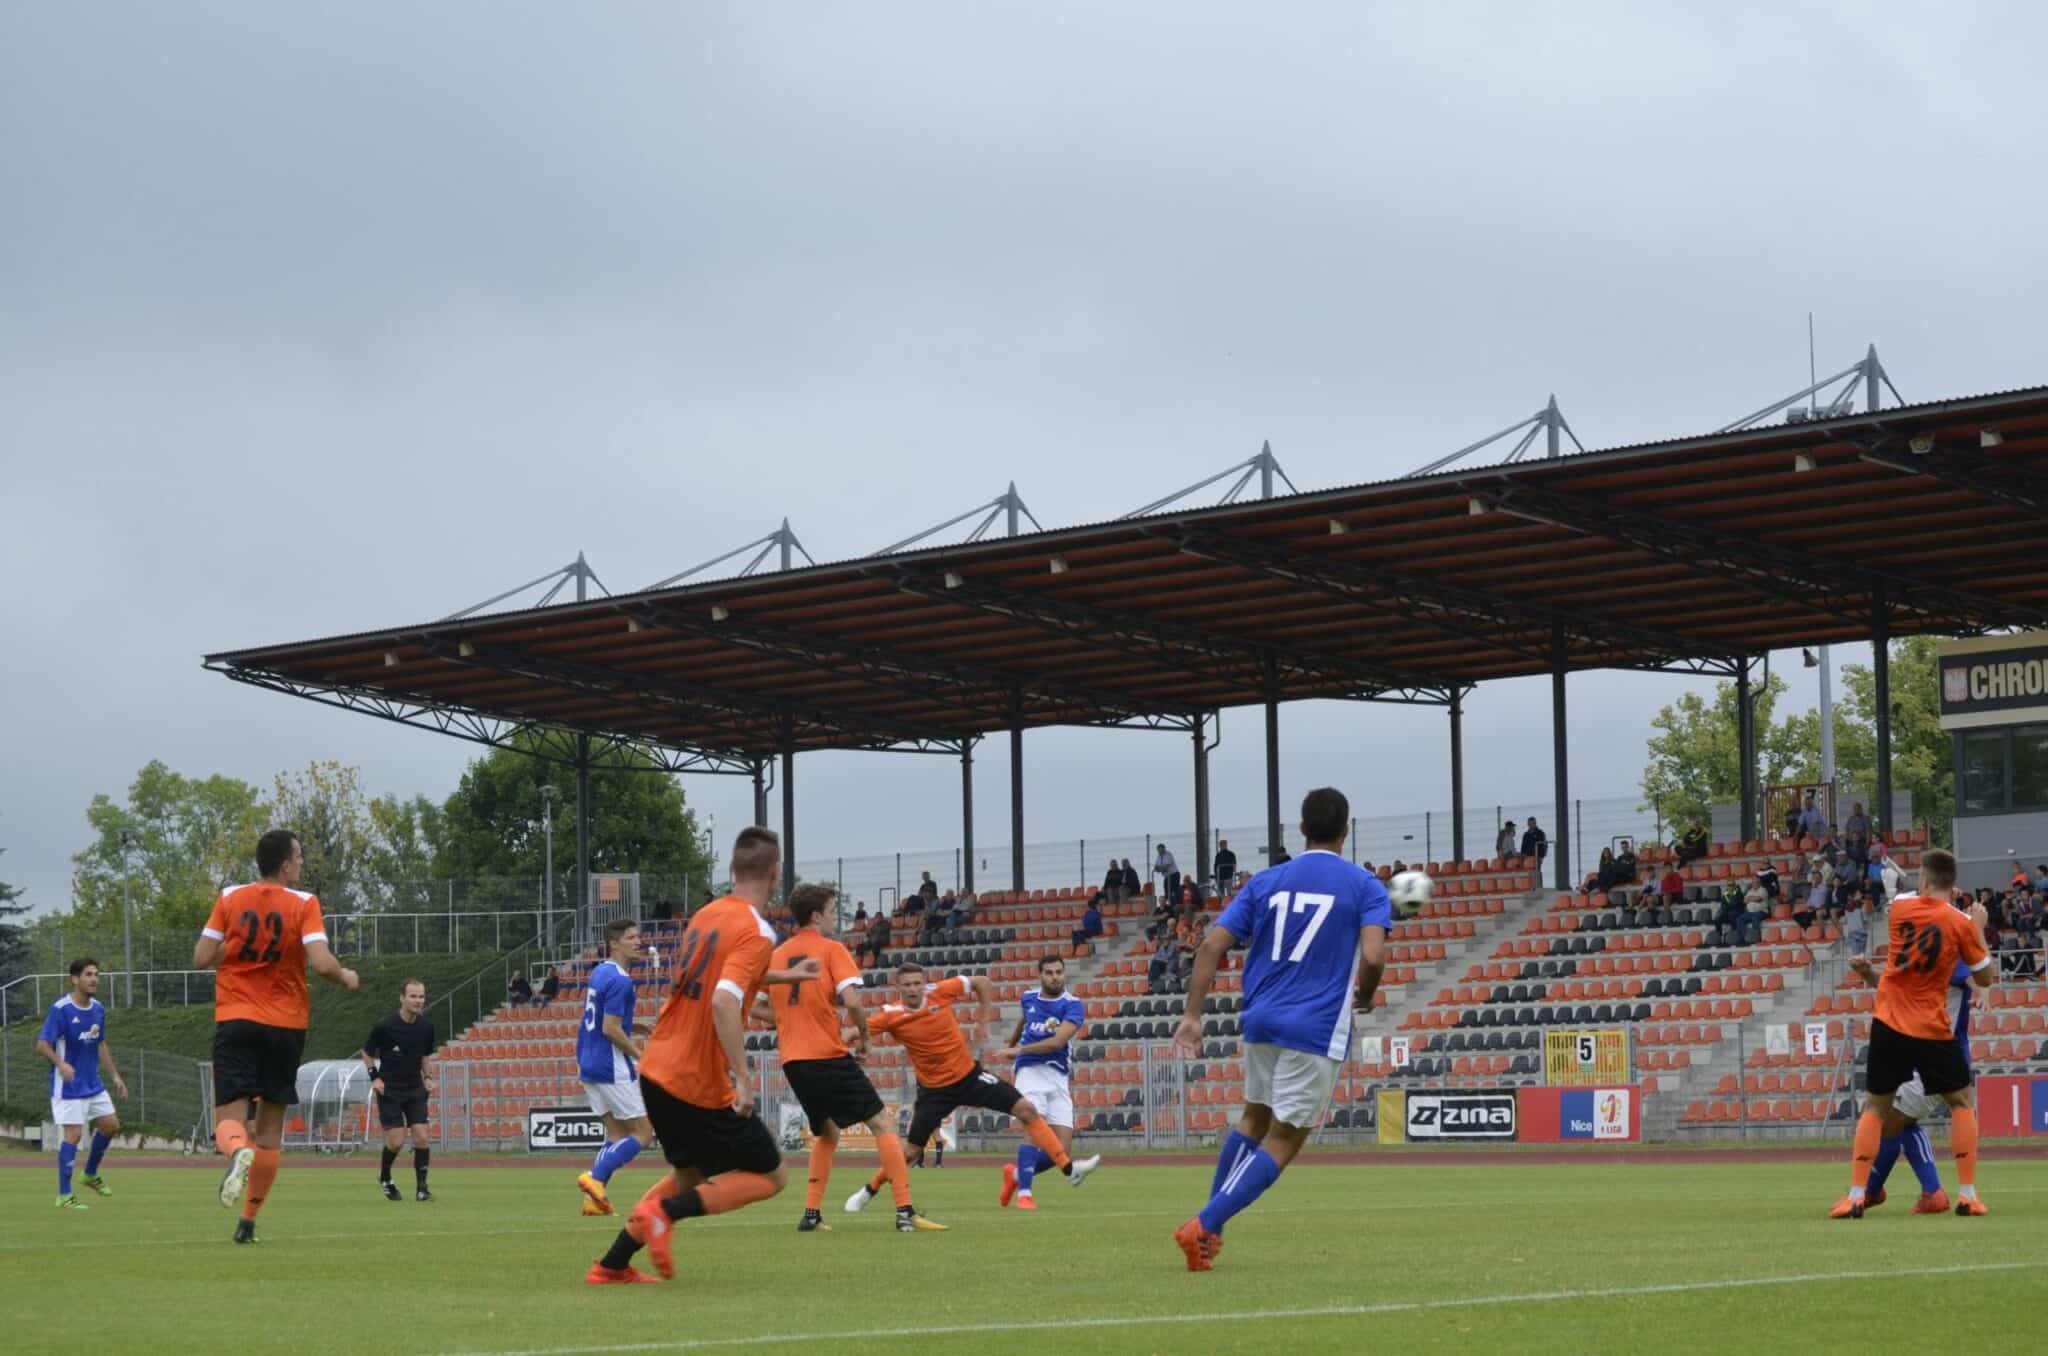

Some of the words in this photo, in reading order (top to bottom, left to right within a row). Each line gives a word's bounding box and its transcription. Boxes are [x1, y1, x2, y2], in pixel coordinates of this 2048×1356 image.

[1970, 658, 2048, 701] CHRO
[238, 909, 283, 961] 22
[1268, 890, 1336, 963] 17
[1580, 1038, 1593, 1061] 5
[1812, 1035, 1819, 1052] E
[1571, 1120, 1592, 1132] Nice
